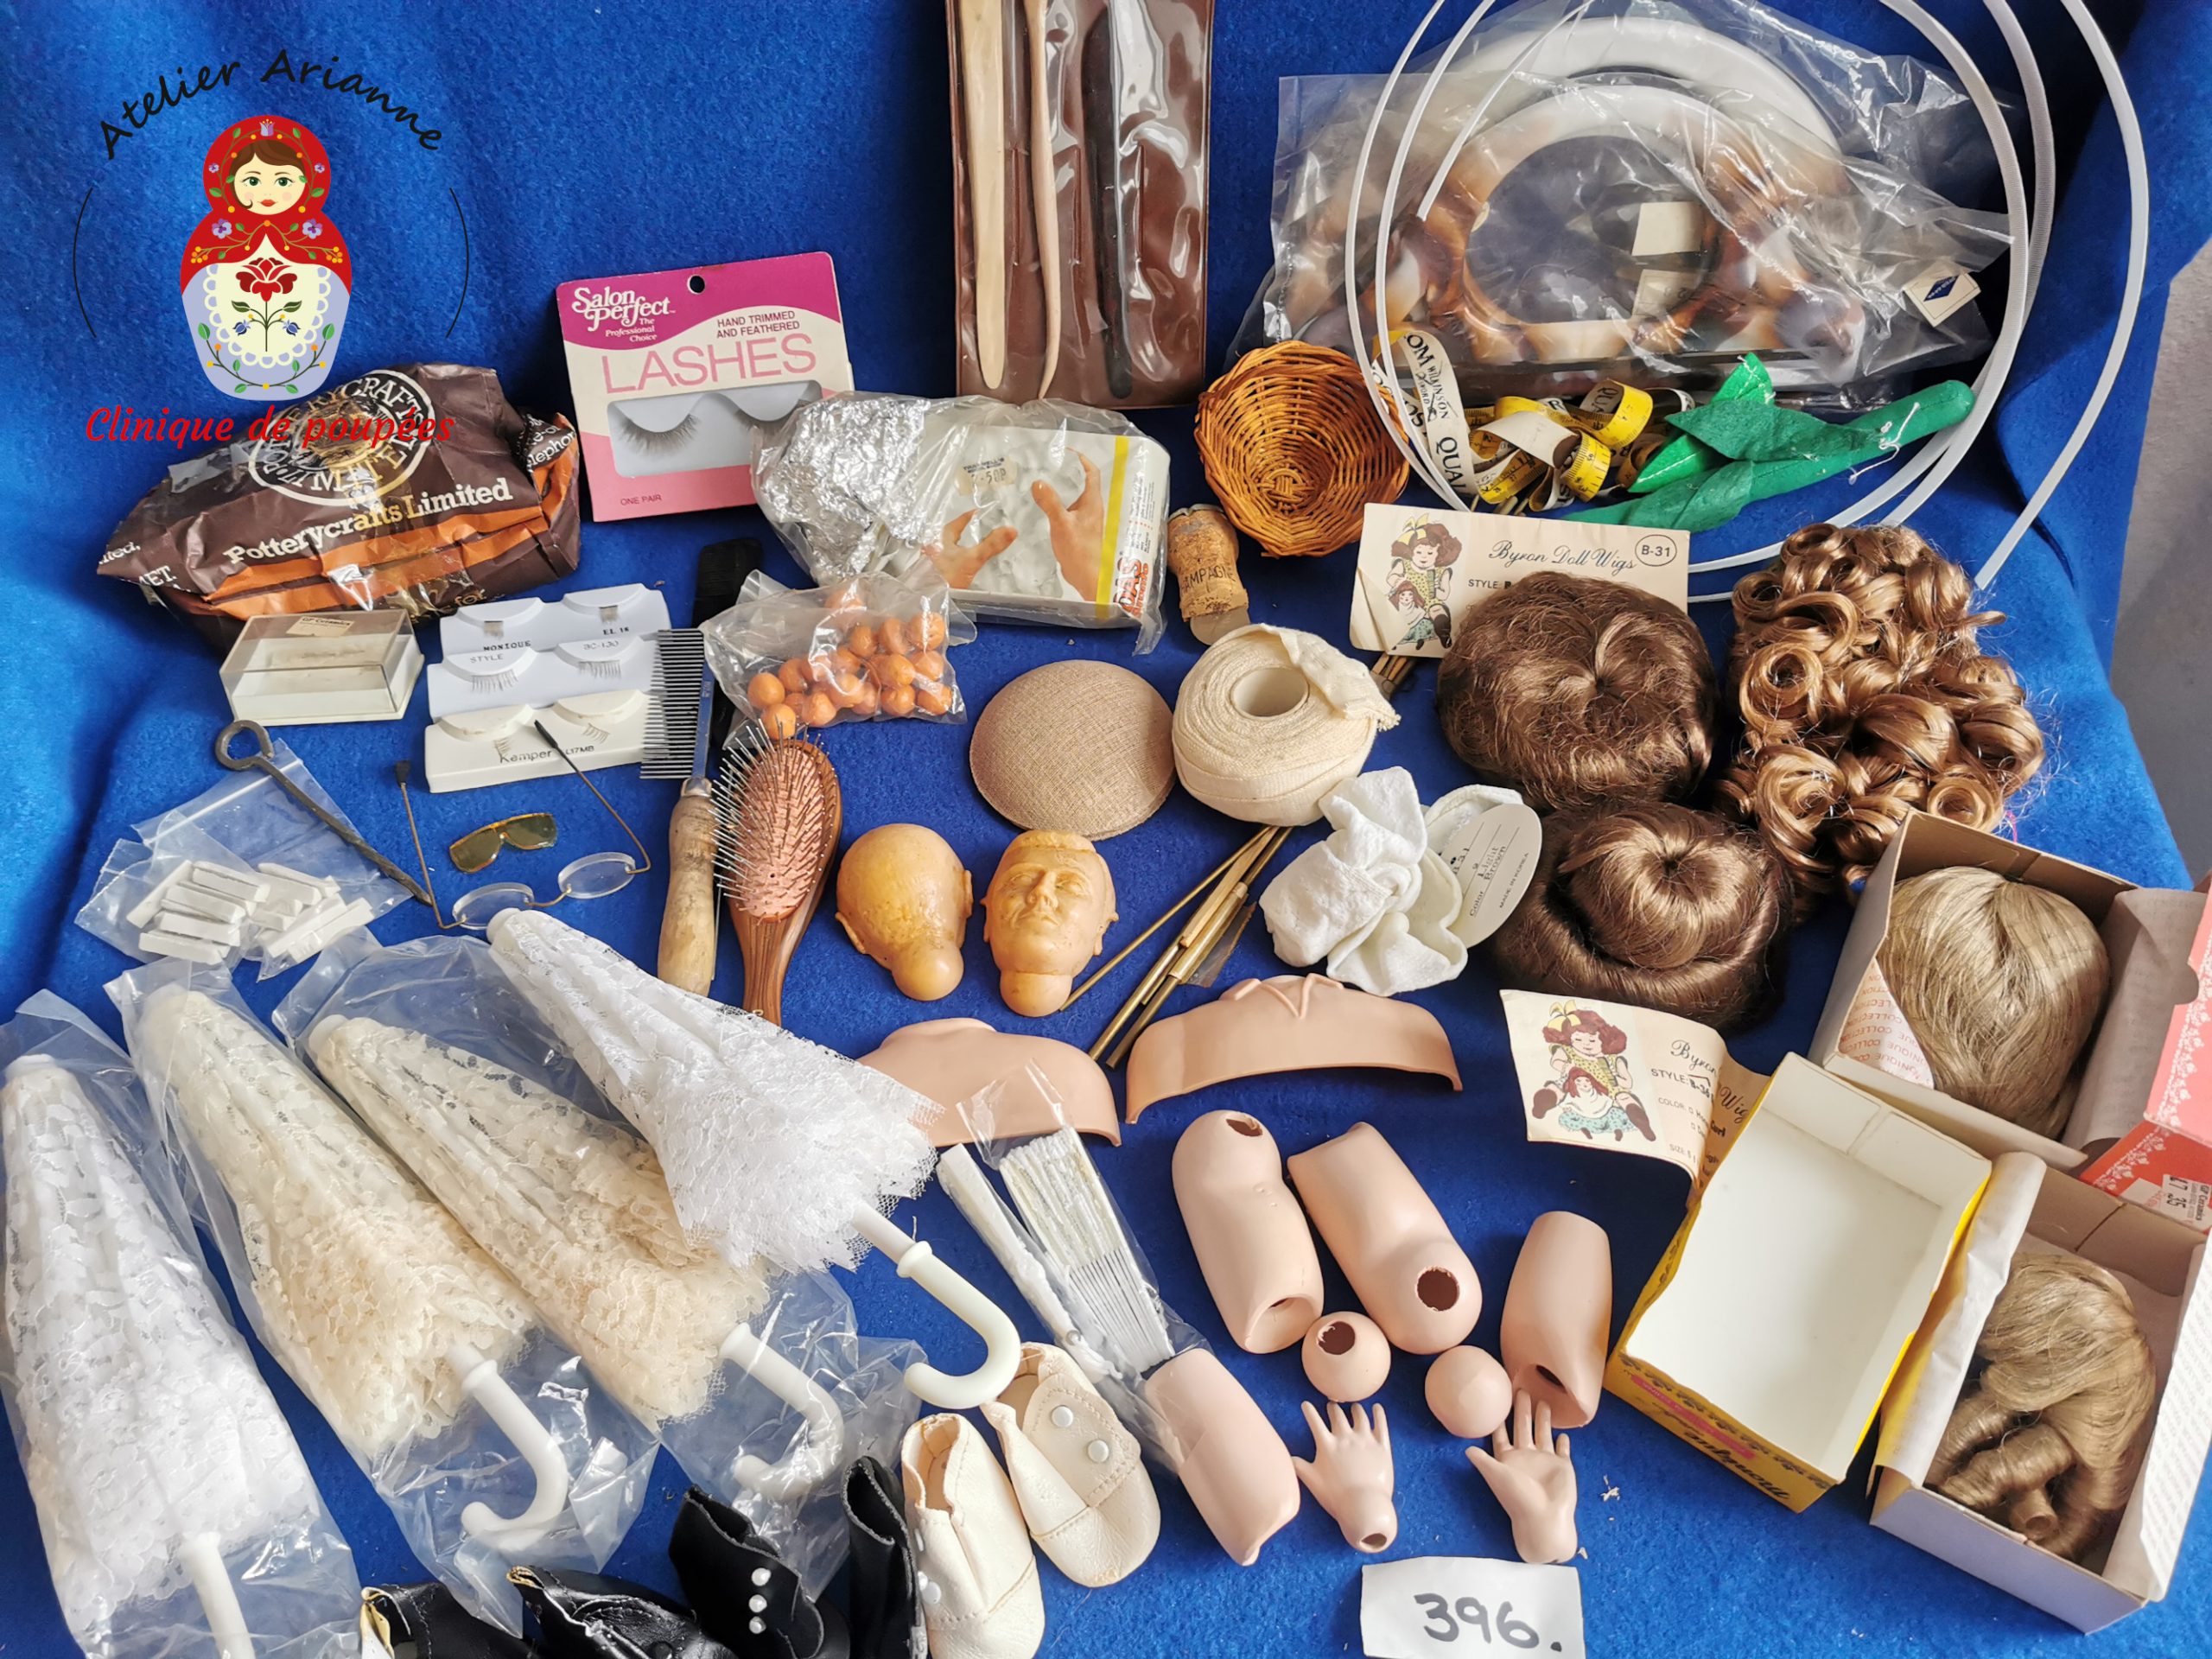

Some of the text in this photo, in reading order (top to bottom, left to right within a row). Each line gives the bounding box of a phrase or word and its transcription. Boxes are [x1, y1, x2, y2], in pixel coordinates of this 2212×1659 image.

[571, 286, 636, 315] Salon
[605, 326, 655, 337] Professional
[639, 317, 655, 326] The
[716, 321, 800, 338] AND FEATHERED
[717, 310, 795, 327] HAND TRIMMED
[629, 334, 658, 342] Choice
[1406, 334, 1434, 366] OM
[601, 334, 817, 394] LASHES
[643, 494, 662, 503] PAIR
[223, 477, 513, 565] Potterycrafts Limited
[1489, 540, 1671, 576] Byron Doll Wigs B-31
[469, 653, 504, 663] STYLE
[483, 640, 531, 651] MONIQUE
[499, 750, 553, 763] Kemper
[1484, 846, 1506, 880] Brown
[1670, 1039, 1718, 1078] Byron
[1720, 1086, 1748, 1123] Wig
[1682, 1431, 1789, 1499] Monique
[1414, 1592, 1562, 1652] 396.
